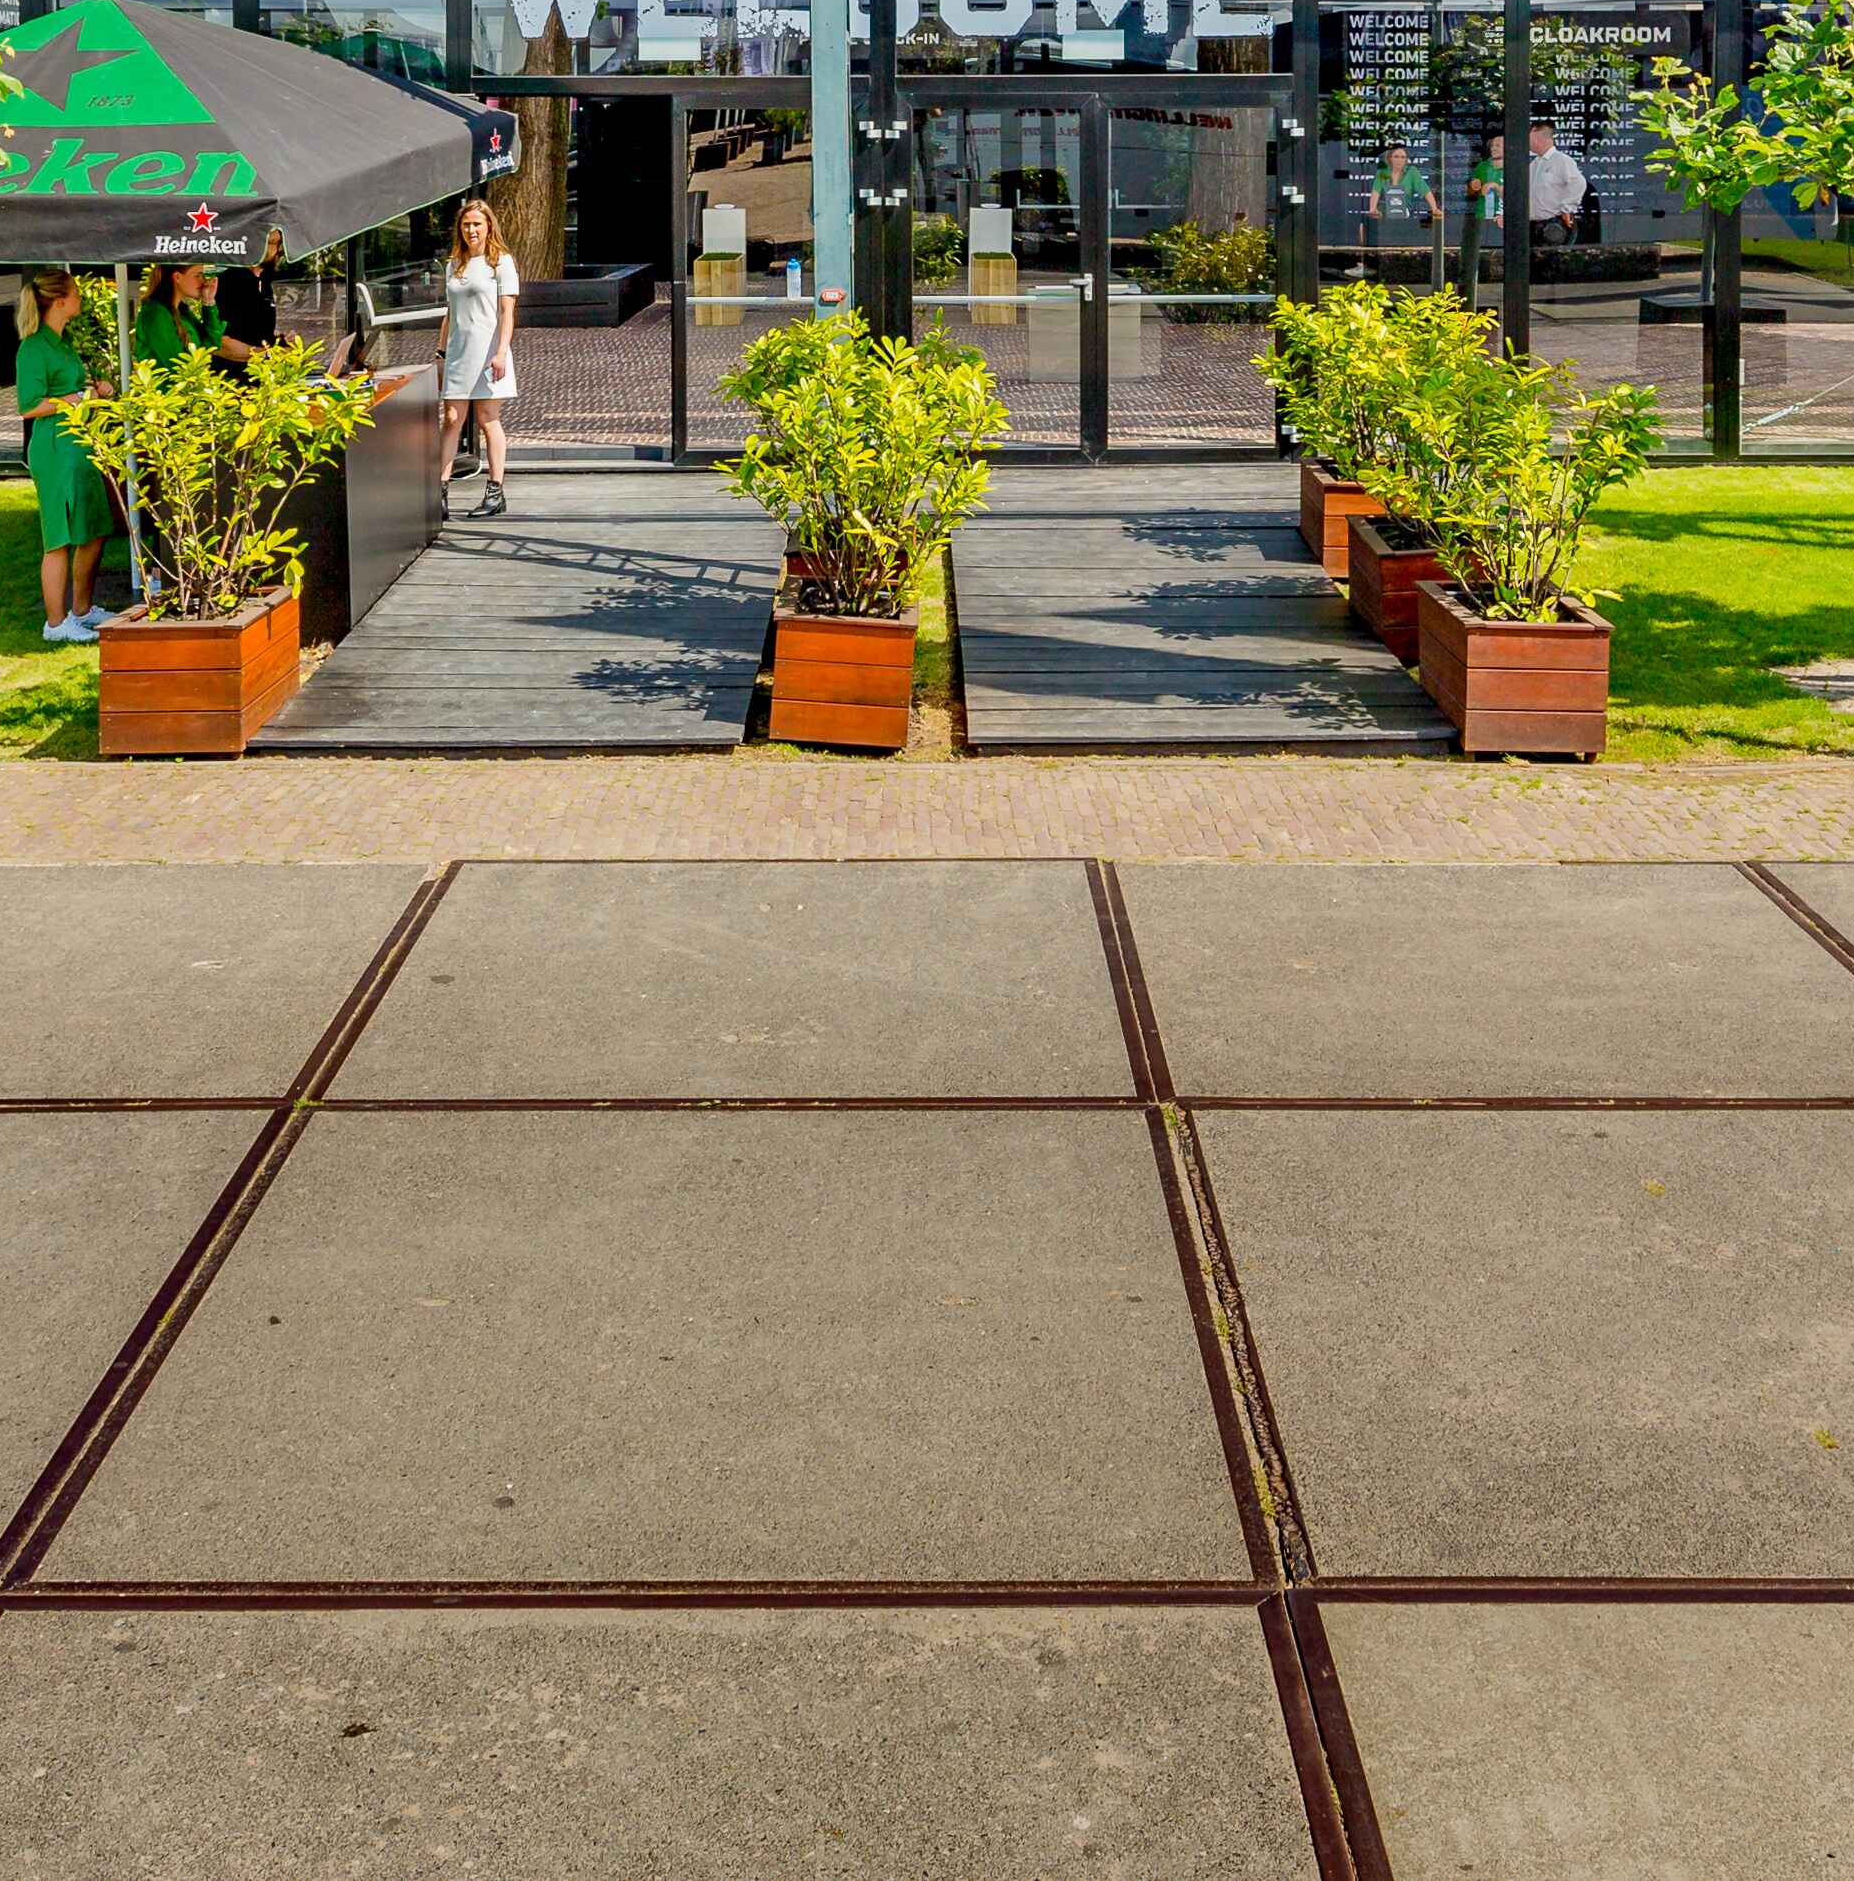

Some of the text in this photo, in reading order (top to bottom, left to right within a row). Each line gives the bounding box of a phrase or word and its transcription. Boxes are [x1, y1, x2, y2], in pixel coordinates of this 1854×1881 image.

[1349, 14, 1430, 28] WELCOME
[1349, 32, 1430, 46] WELCOME
[1529, 26, 1672, 44] CLOAKROOM
[1349, 50, 1430, 63] WELCOME
[87, 94, 135, 108] 1873
[153, 235, 248, 255] Heineken
